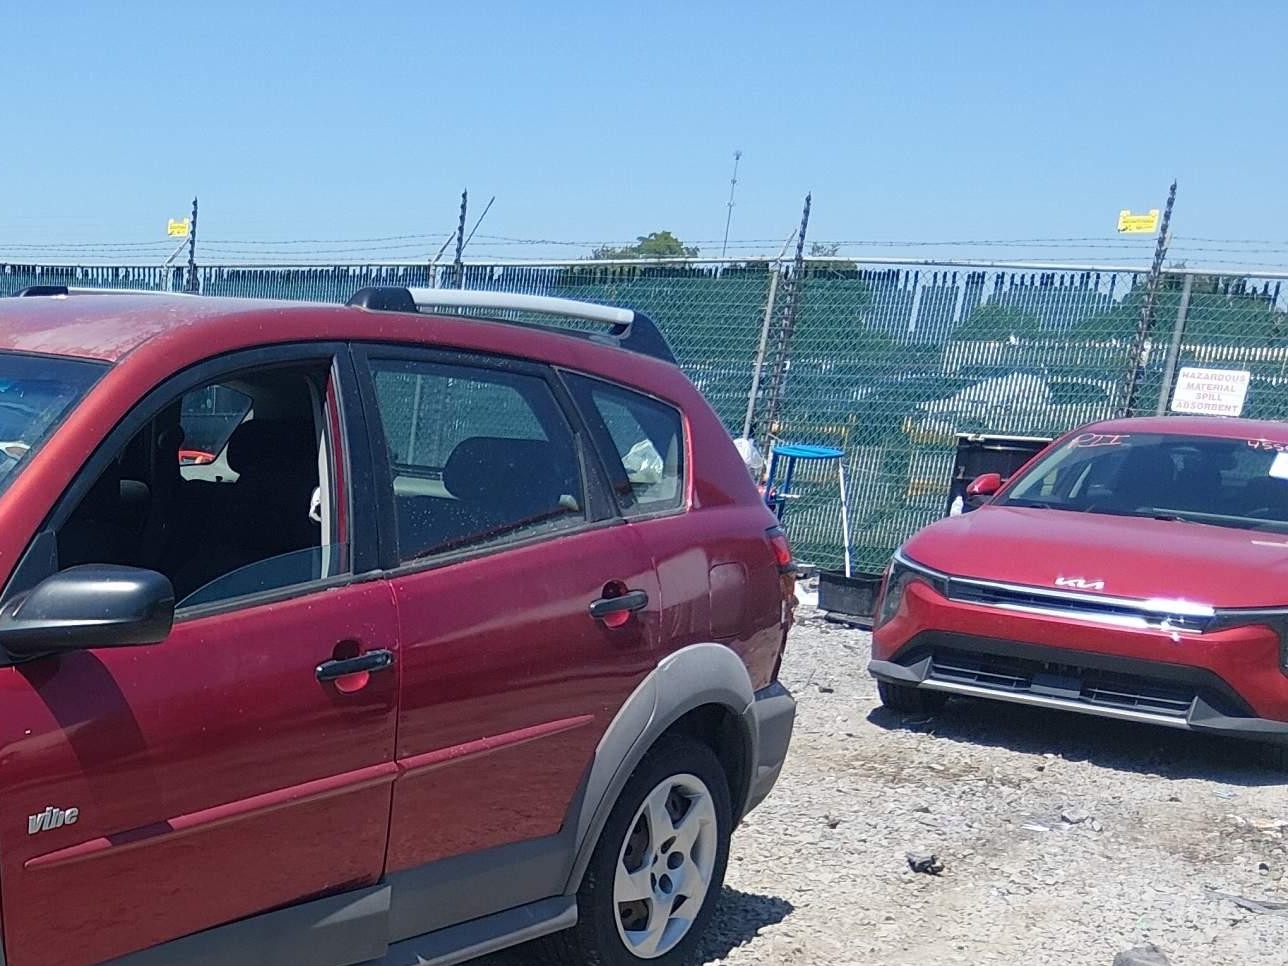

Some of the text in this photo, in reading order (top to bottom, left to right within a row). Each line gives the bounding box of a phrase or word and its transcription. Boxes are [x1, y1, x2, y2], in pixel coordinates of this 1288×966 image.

[1182, 371, 1247, 382] HAZARDOUS
[1186, 382, 1237, 393] MATERIAL
[1195, 392, 1223, 401] SPILL
[1175, 401, 1240, 413] ABSORBENT
[28, 806, 79, 835] vibe
